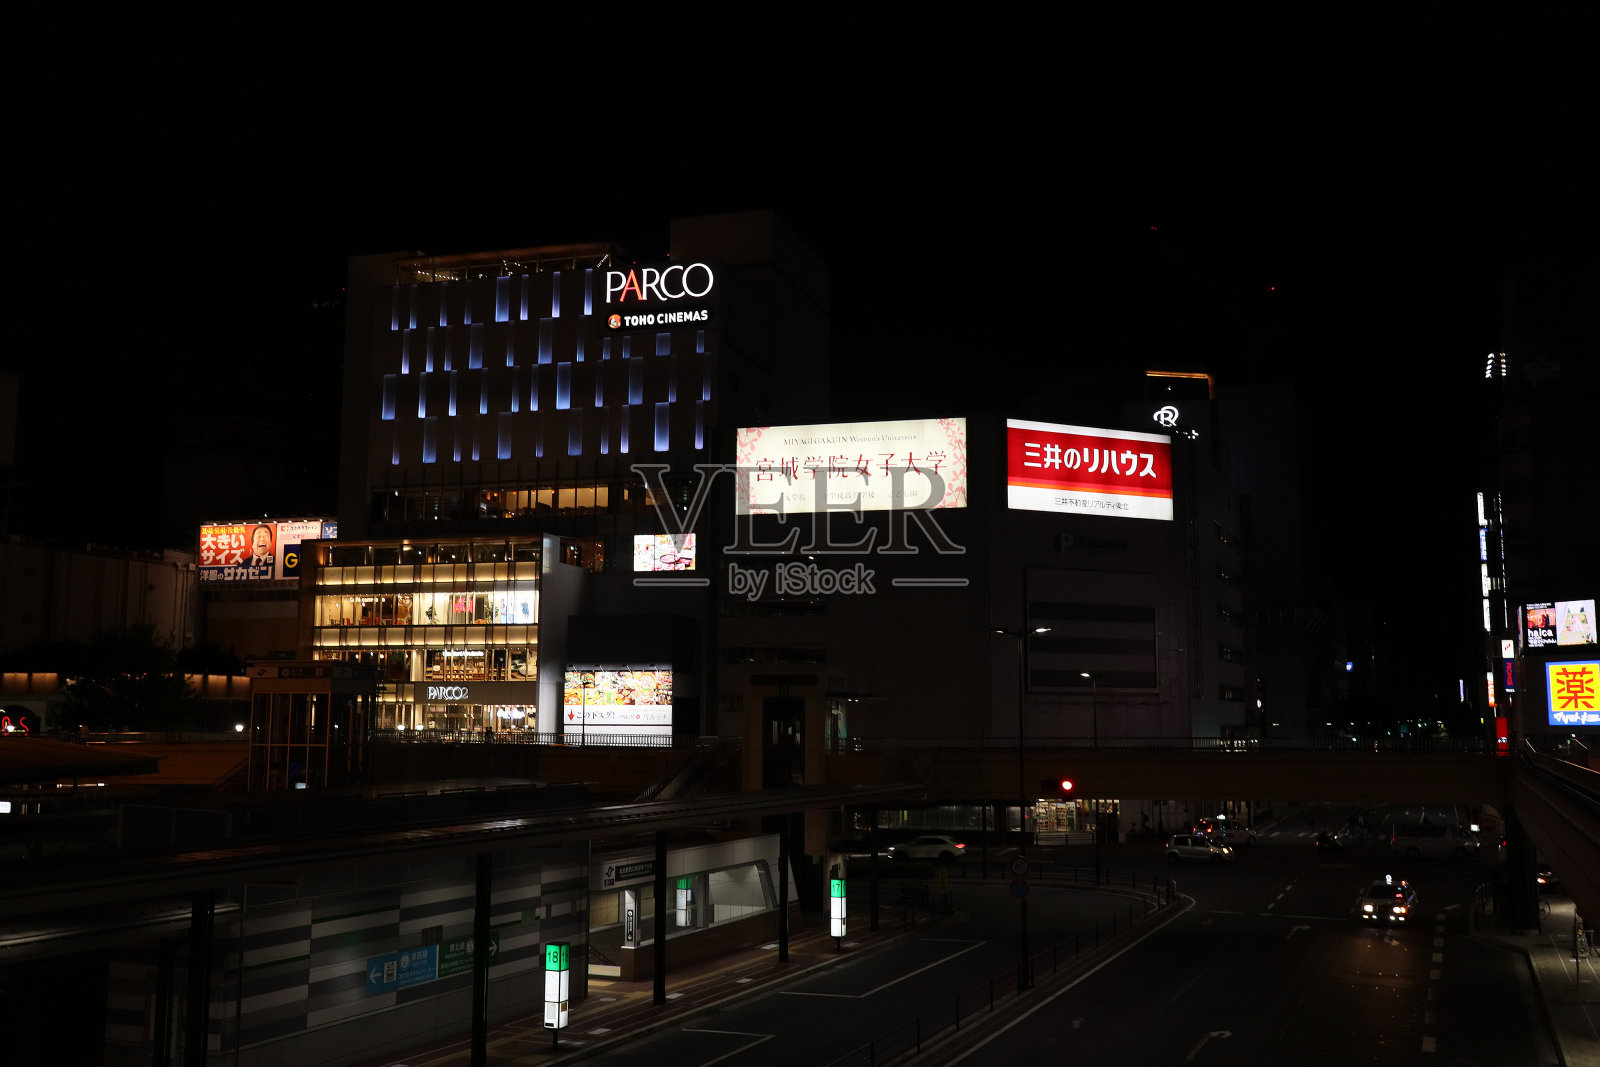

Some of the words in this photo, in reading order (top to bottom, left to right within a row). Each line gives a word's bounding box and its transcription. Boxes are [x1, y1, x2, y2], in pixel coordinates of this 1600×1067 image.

[606, 263, 714, 303] PARCO
[624, 314, 655, 326] TOHO
[657, 310, 708, 324] CINEMAS
[755, 450, 947, 482] 宮城学院女子大学
[1023, 442, 1157, 478] 三井のリハウス
[201, 534, 245, 550] 大きい
[201, 548, 245, 565] サイズ
[200, 566, 272, 581] 洋服のサカゼン
[427, 686, 469, 700] PARCO2
[1556, 667, 1595, 709] 薬
[548, 951, 558, 963] 18
